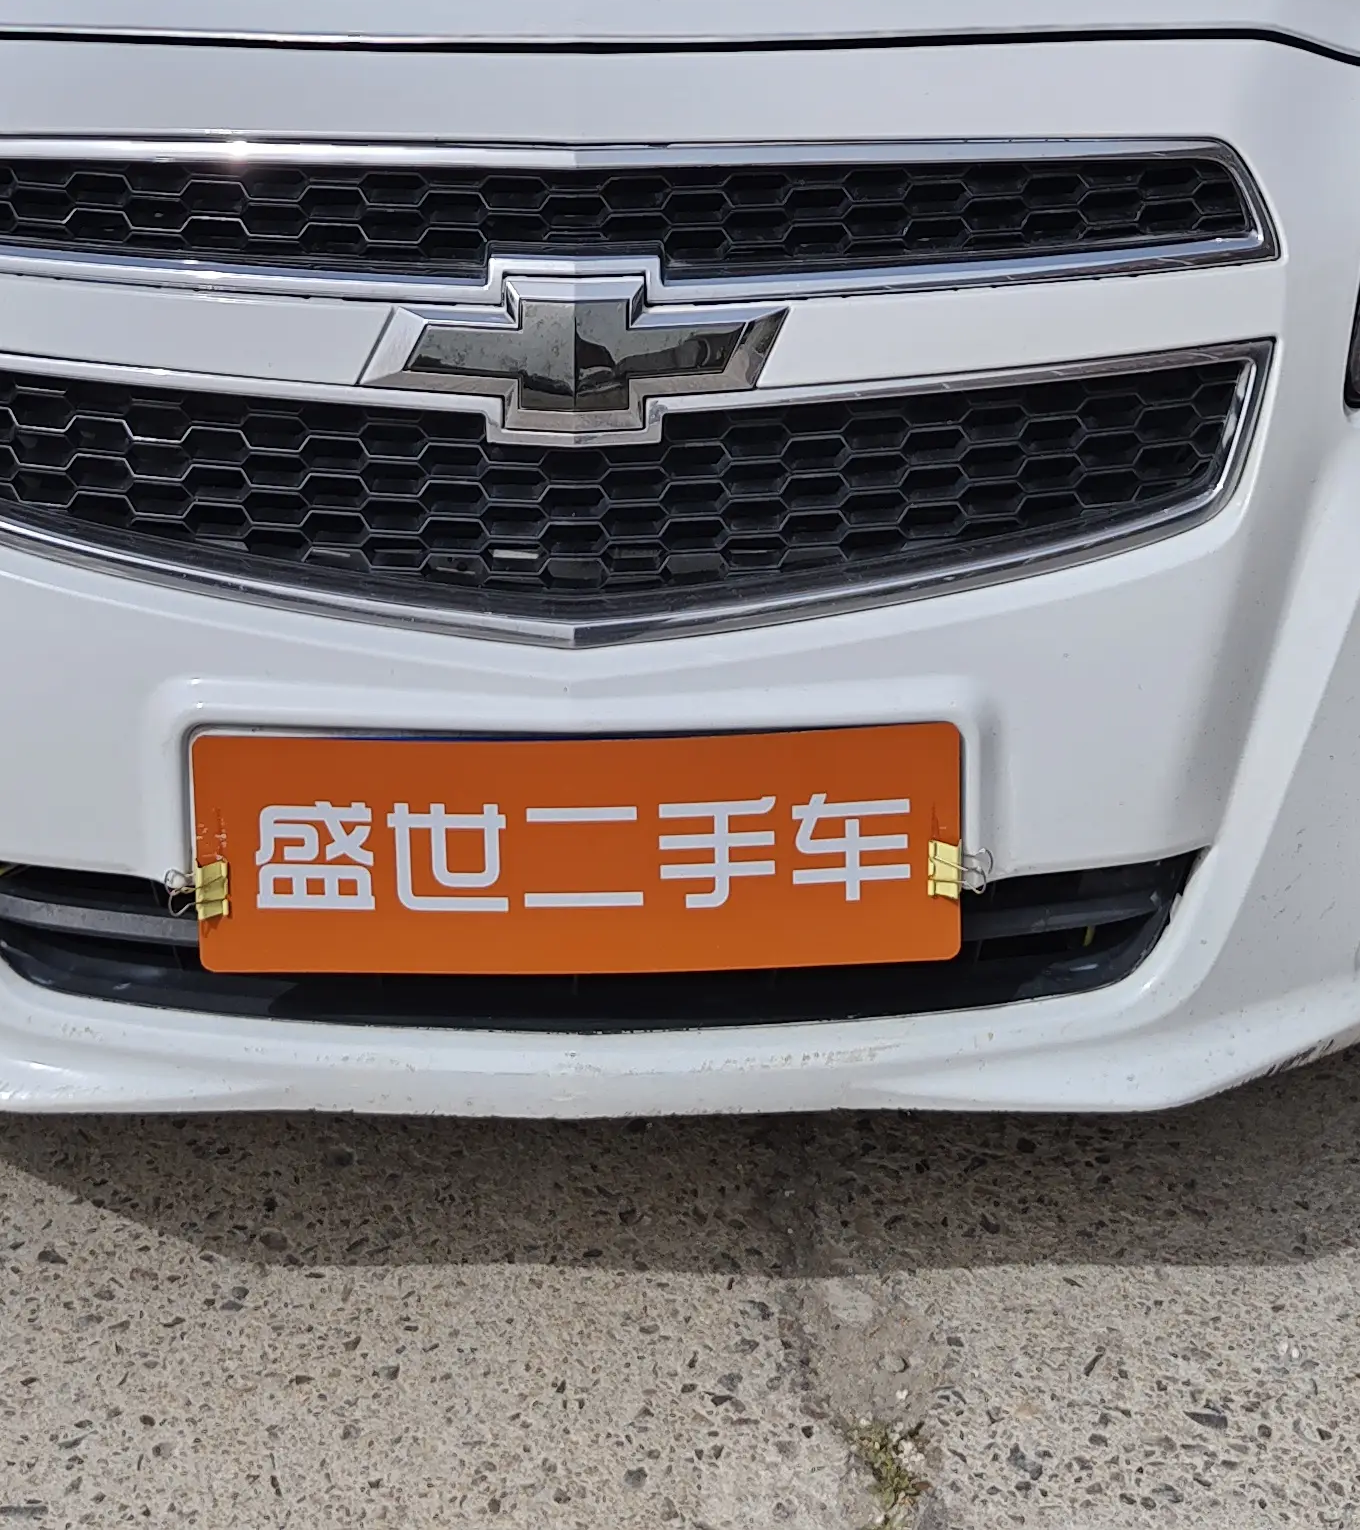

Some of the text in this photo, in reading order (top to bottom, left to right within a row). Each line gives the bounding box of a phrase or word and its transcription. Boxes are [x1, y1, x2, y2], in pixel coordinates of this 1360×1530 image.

[253, 793, 911, 912] 盛世二手车
